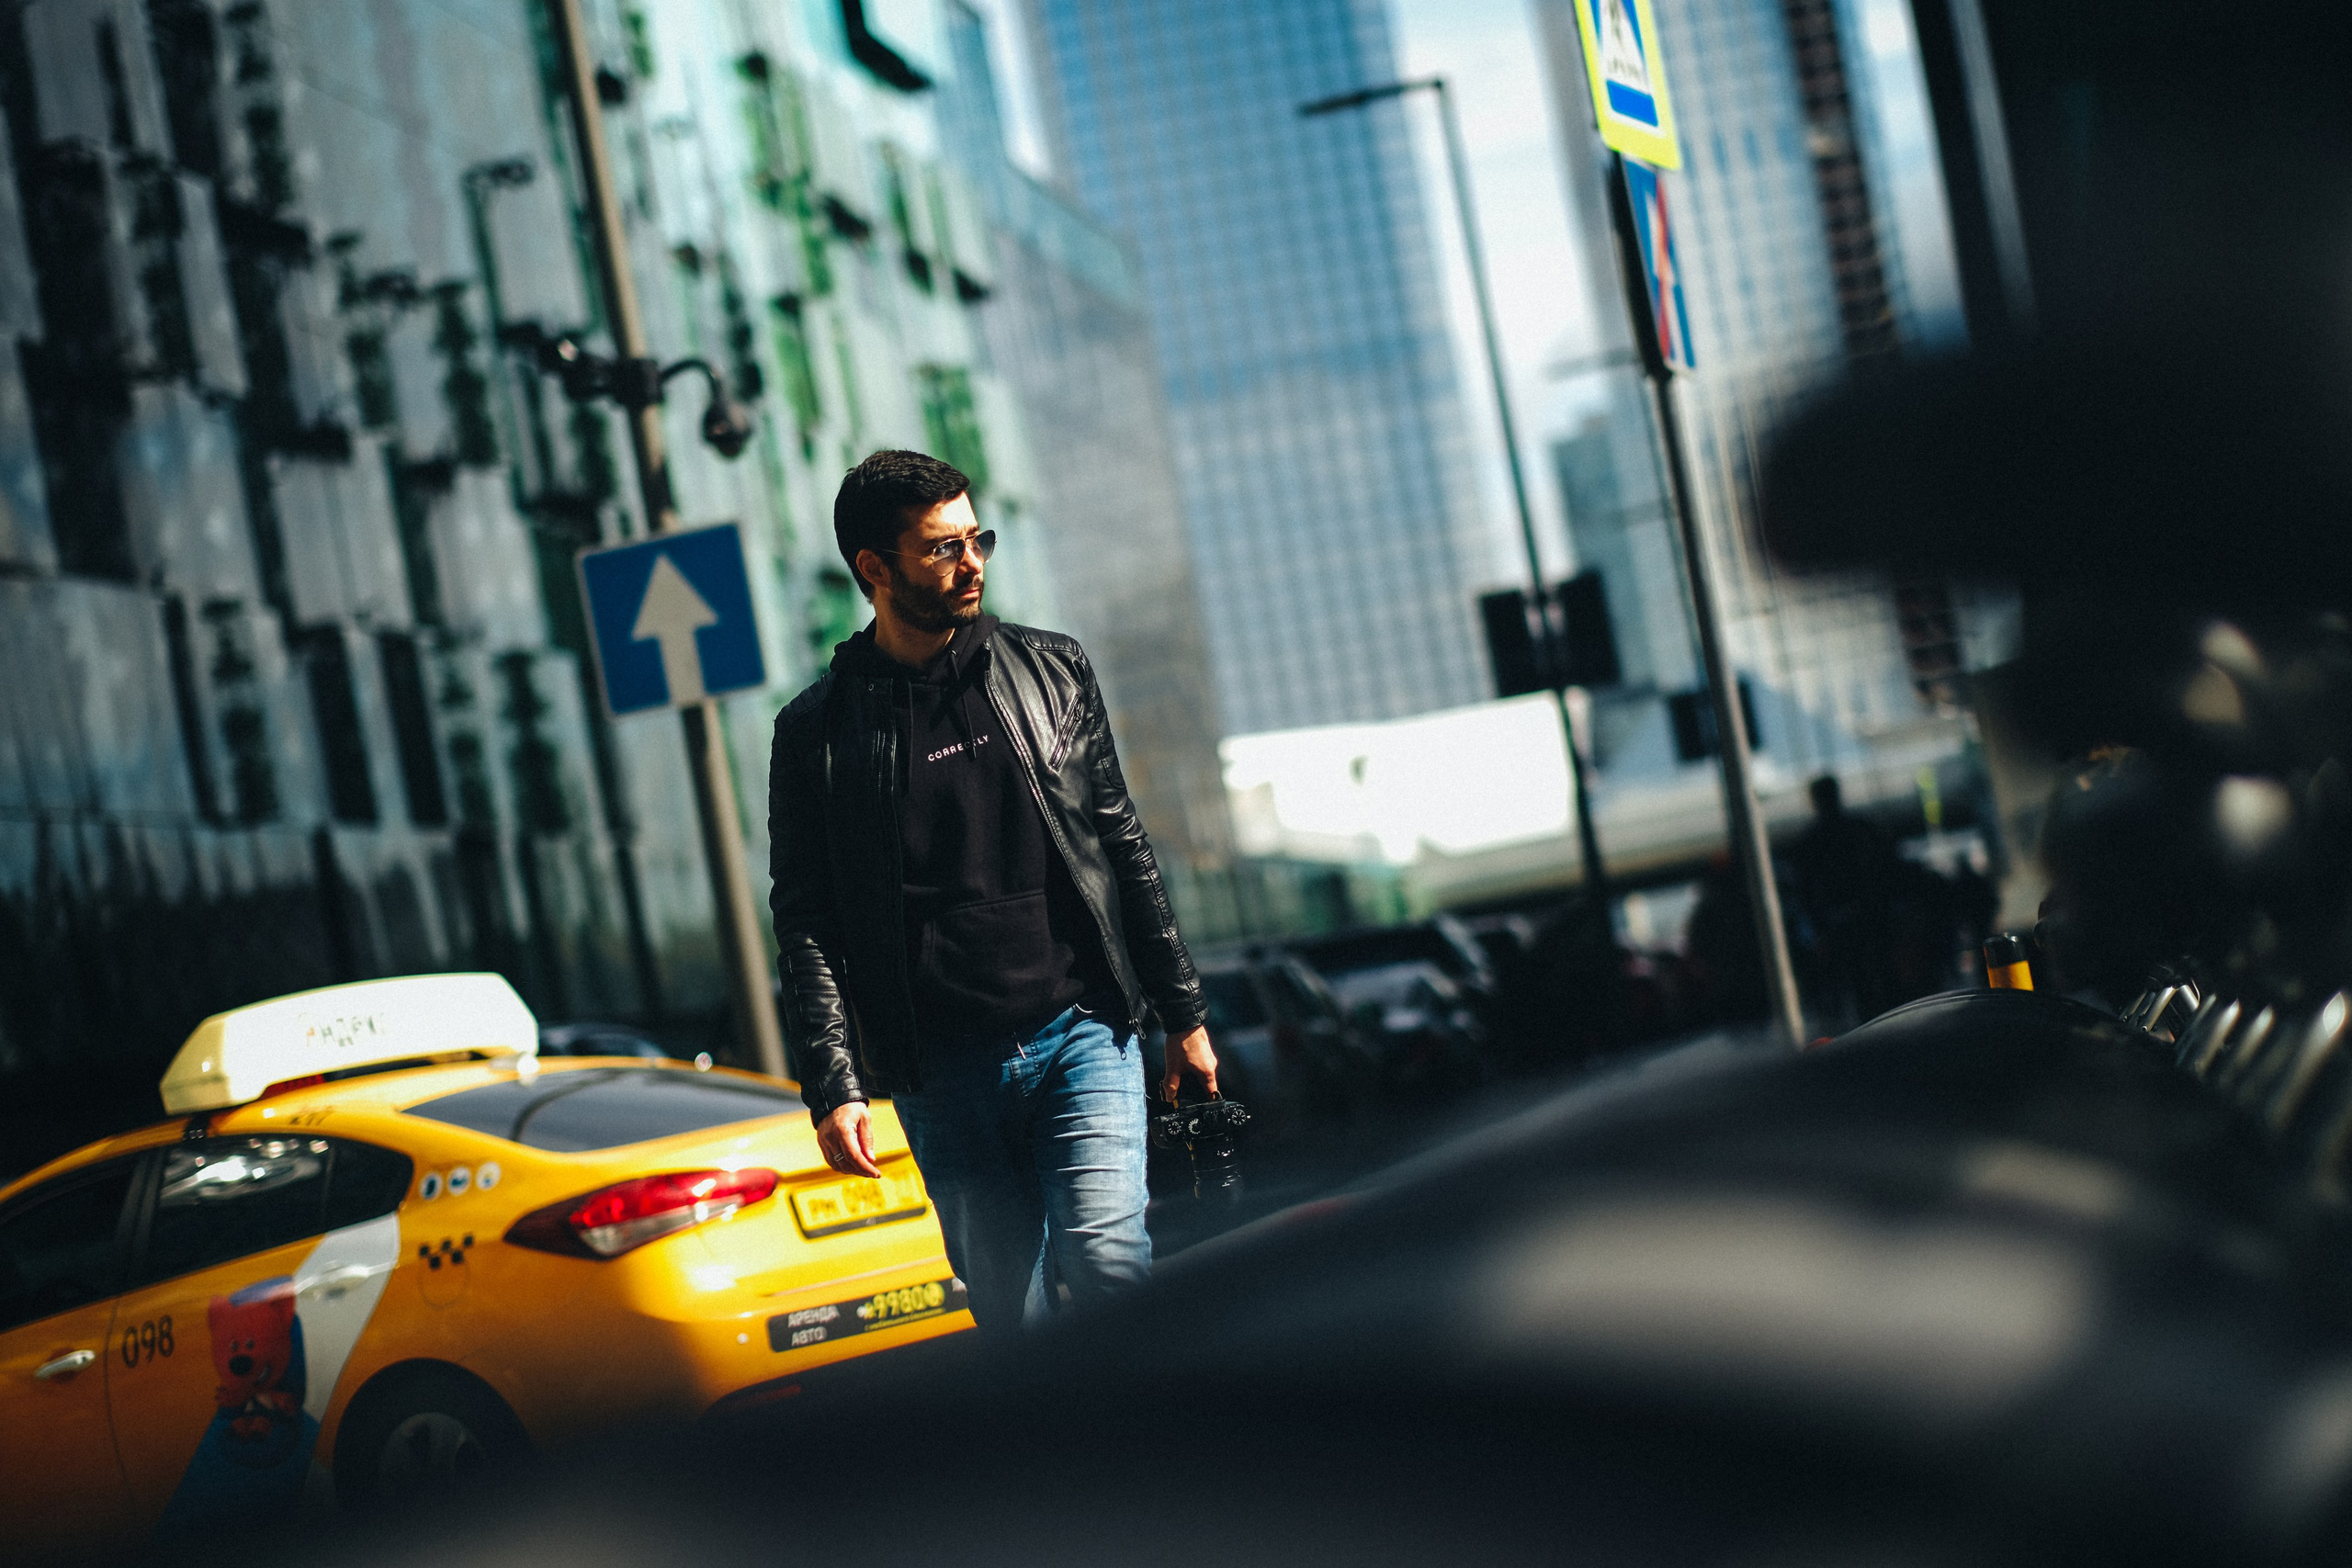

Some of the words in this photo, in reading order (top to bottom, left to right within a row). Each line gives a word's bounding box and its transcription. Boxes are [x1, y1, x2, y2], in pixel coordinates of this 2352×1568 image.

[787, 1305, 840, 1328] АРЕНДА
[122, 1314, 175, 1370] 098
[791, 1325, 828, 1347] АВТО
